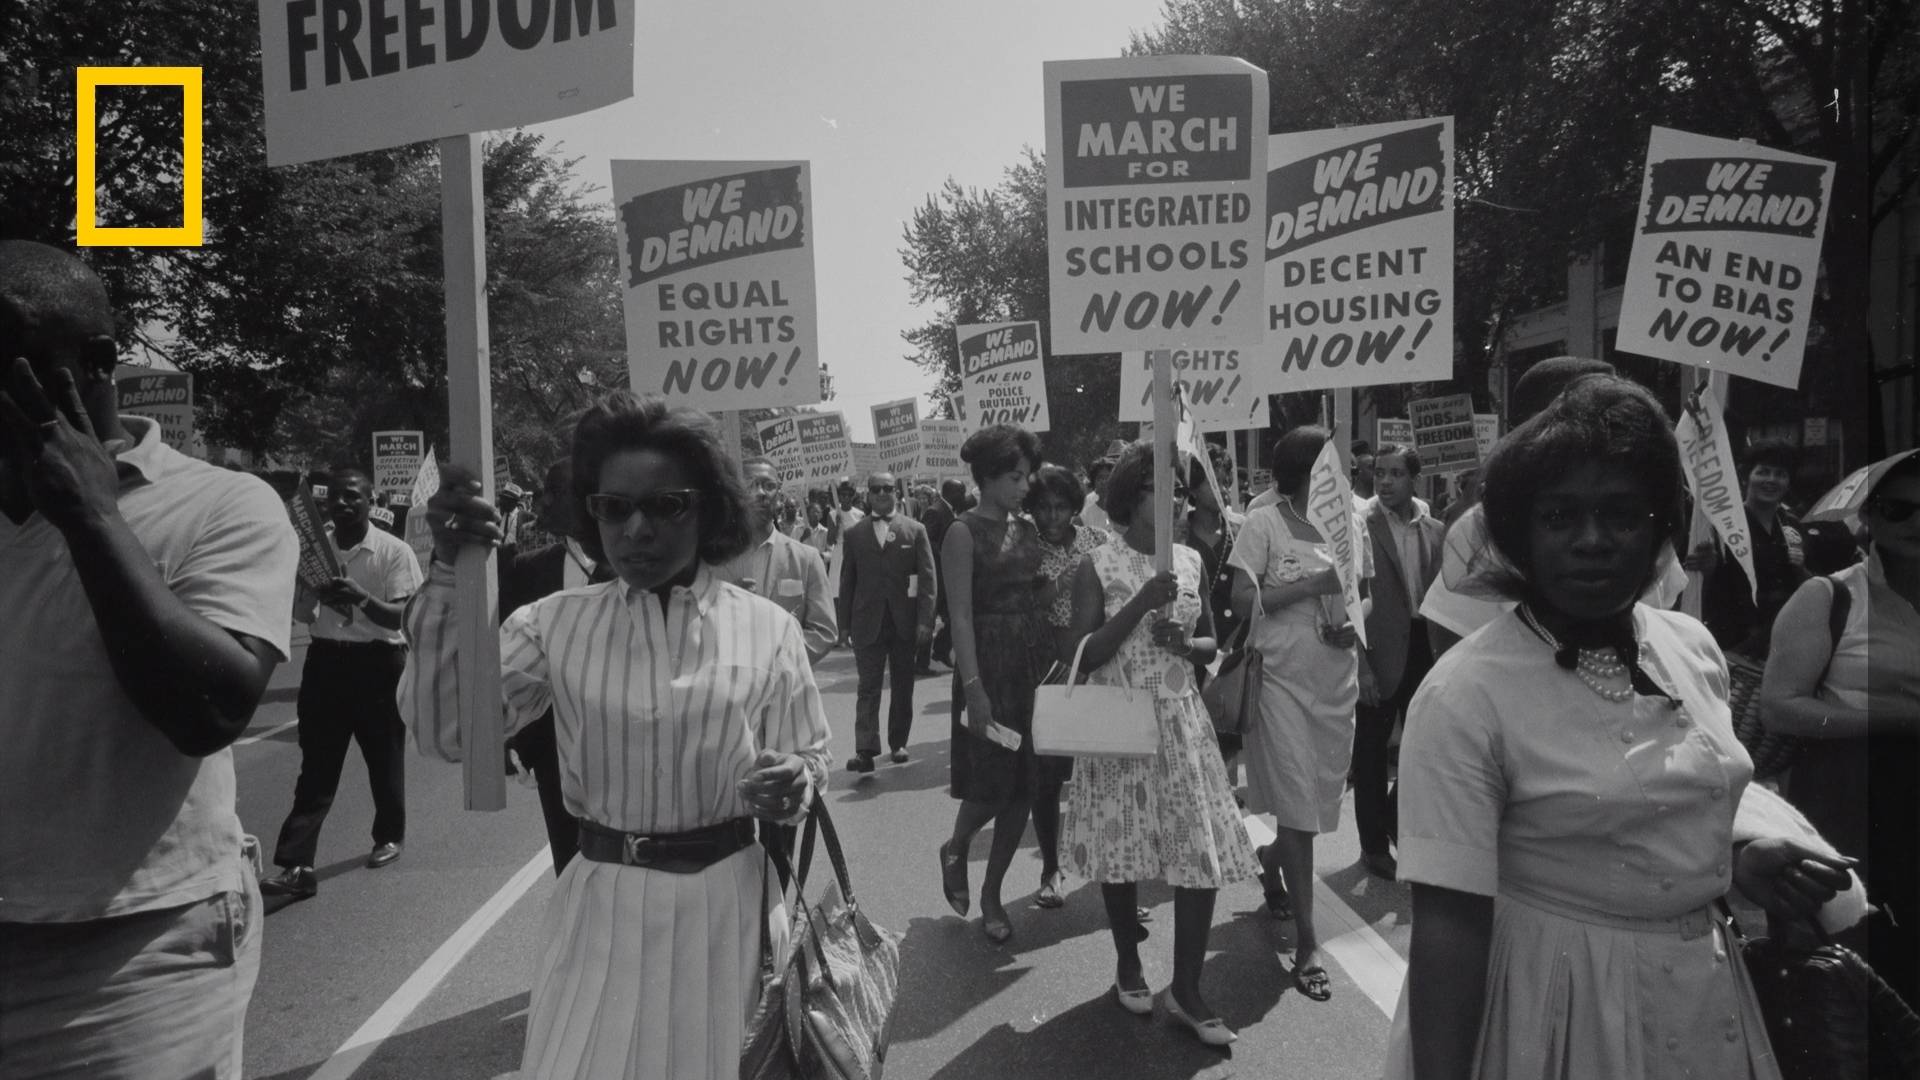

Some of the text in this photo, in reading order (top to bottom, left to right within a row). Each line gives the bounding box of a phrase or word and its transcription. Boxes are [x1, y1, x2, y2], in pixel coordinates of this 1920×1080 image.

[1129, 84, 1186, 114] WE
[1077, 116, 1238, 158] MARCH
[1127, 160, 1190, 179] FOR
[1313, 142, 1383, 195] WE
[1705, 161, 1773, 192] WE
[682, 178, 746, 223] WE
[1064, 192, 1251, 231] INTEGRATED
[1266, 166, 1439, 250] DEMAND
[1655, 193, 1815, 227] DEMAND
[639, 204, 798, 273] DEMAND
[1065, 239, 1249, 277] SCHOOLS
[1283, 246, 1428, 288] DECENT
[1655, 240, 1803, 291] AN END
[657, 280, 790, 311] EQUAL
[1079, 278, 1241, 334] NOW!
[1655, 272, 1795, 325] TO BIAS
[1269, 288, 1442, 331] HOUSING
[657, 315, 796, 348] RIGHTS
[985, 328, 1013, 349] WE
[1280, 317, 1434, 373] NOW!
[1648, 307, 1791, 362] NOW!
[968, 339, 1035, 373] DEMAND
[1143, 349, 1240, 371] RGHTS
[140, 376, 167, 391] WE
[662, 345, 802, 395] NOW!
[975, 370, 1032, 384] AN END
[122, 387, 187, 406] DEMAND
[979, 396, 1032, 409] BRUTALITY
[988, 386, 1024, 398] POLICE
[889, 407, 901, 416] WE
[980, 402, 1041, 427] NOW!
[1415, 402, 1440, 413] UAW
[1416, 411, 1453, 428] JOBS
[775, 420, 792, 435] WE
[802, 424, 840, 438] MARCH
[880, 413, 913, 430] MARCH
[379, 442, 417, 451] MARCH
[802, 440, 847, 454] INTEGRATED
[880, 438, 899, 449] FIRST
[900, 432, 920, 444] CLASS
[1416, 425, 1474, 446] FREEDOM
[804, 450, 849, 464] SCHOOLS
[879, 442, 921, 461] CITIZENSHIP
[887, 454, 920, 473] NOW!
[1696, 405, 1734, 516] FREEDOM
[811, 460, 849, 478] NOW!
[1309, 462, 1351, 572] FREEDOM
